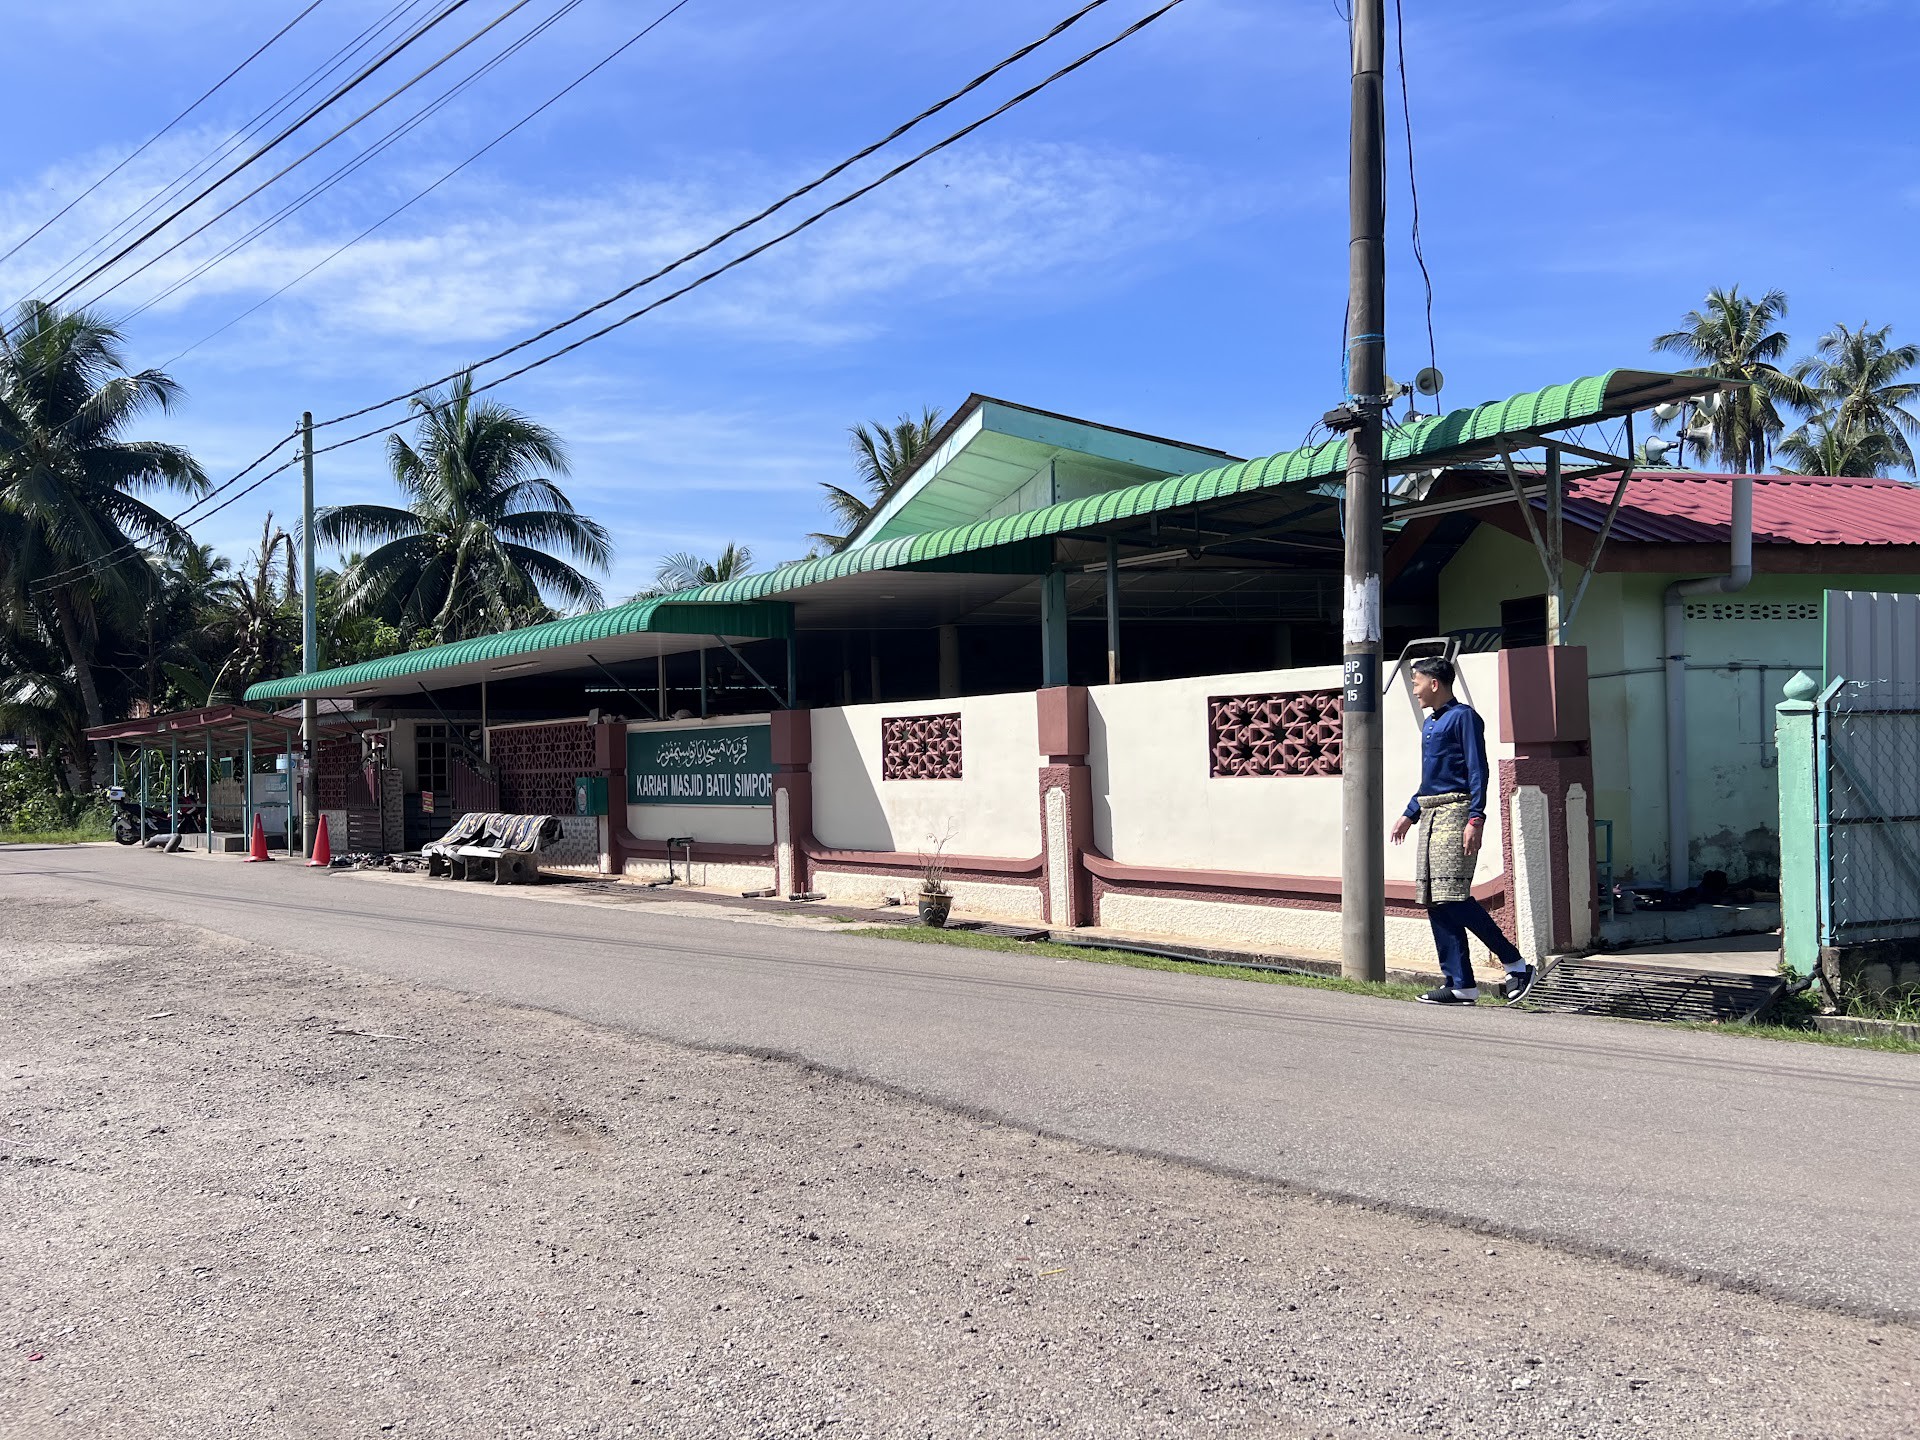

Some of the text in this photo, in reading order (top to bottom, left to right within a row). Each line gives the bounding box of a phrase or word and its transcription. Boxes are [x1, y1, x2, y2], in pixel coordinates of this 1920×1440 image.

[1345, 661, 1360, 673] BP
[1346, 690, 1358, 702] 15
[636, 773, 773, 797] KARIAH MASJID BATU SIMPOR
